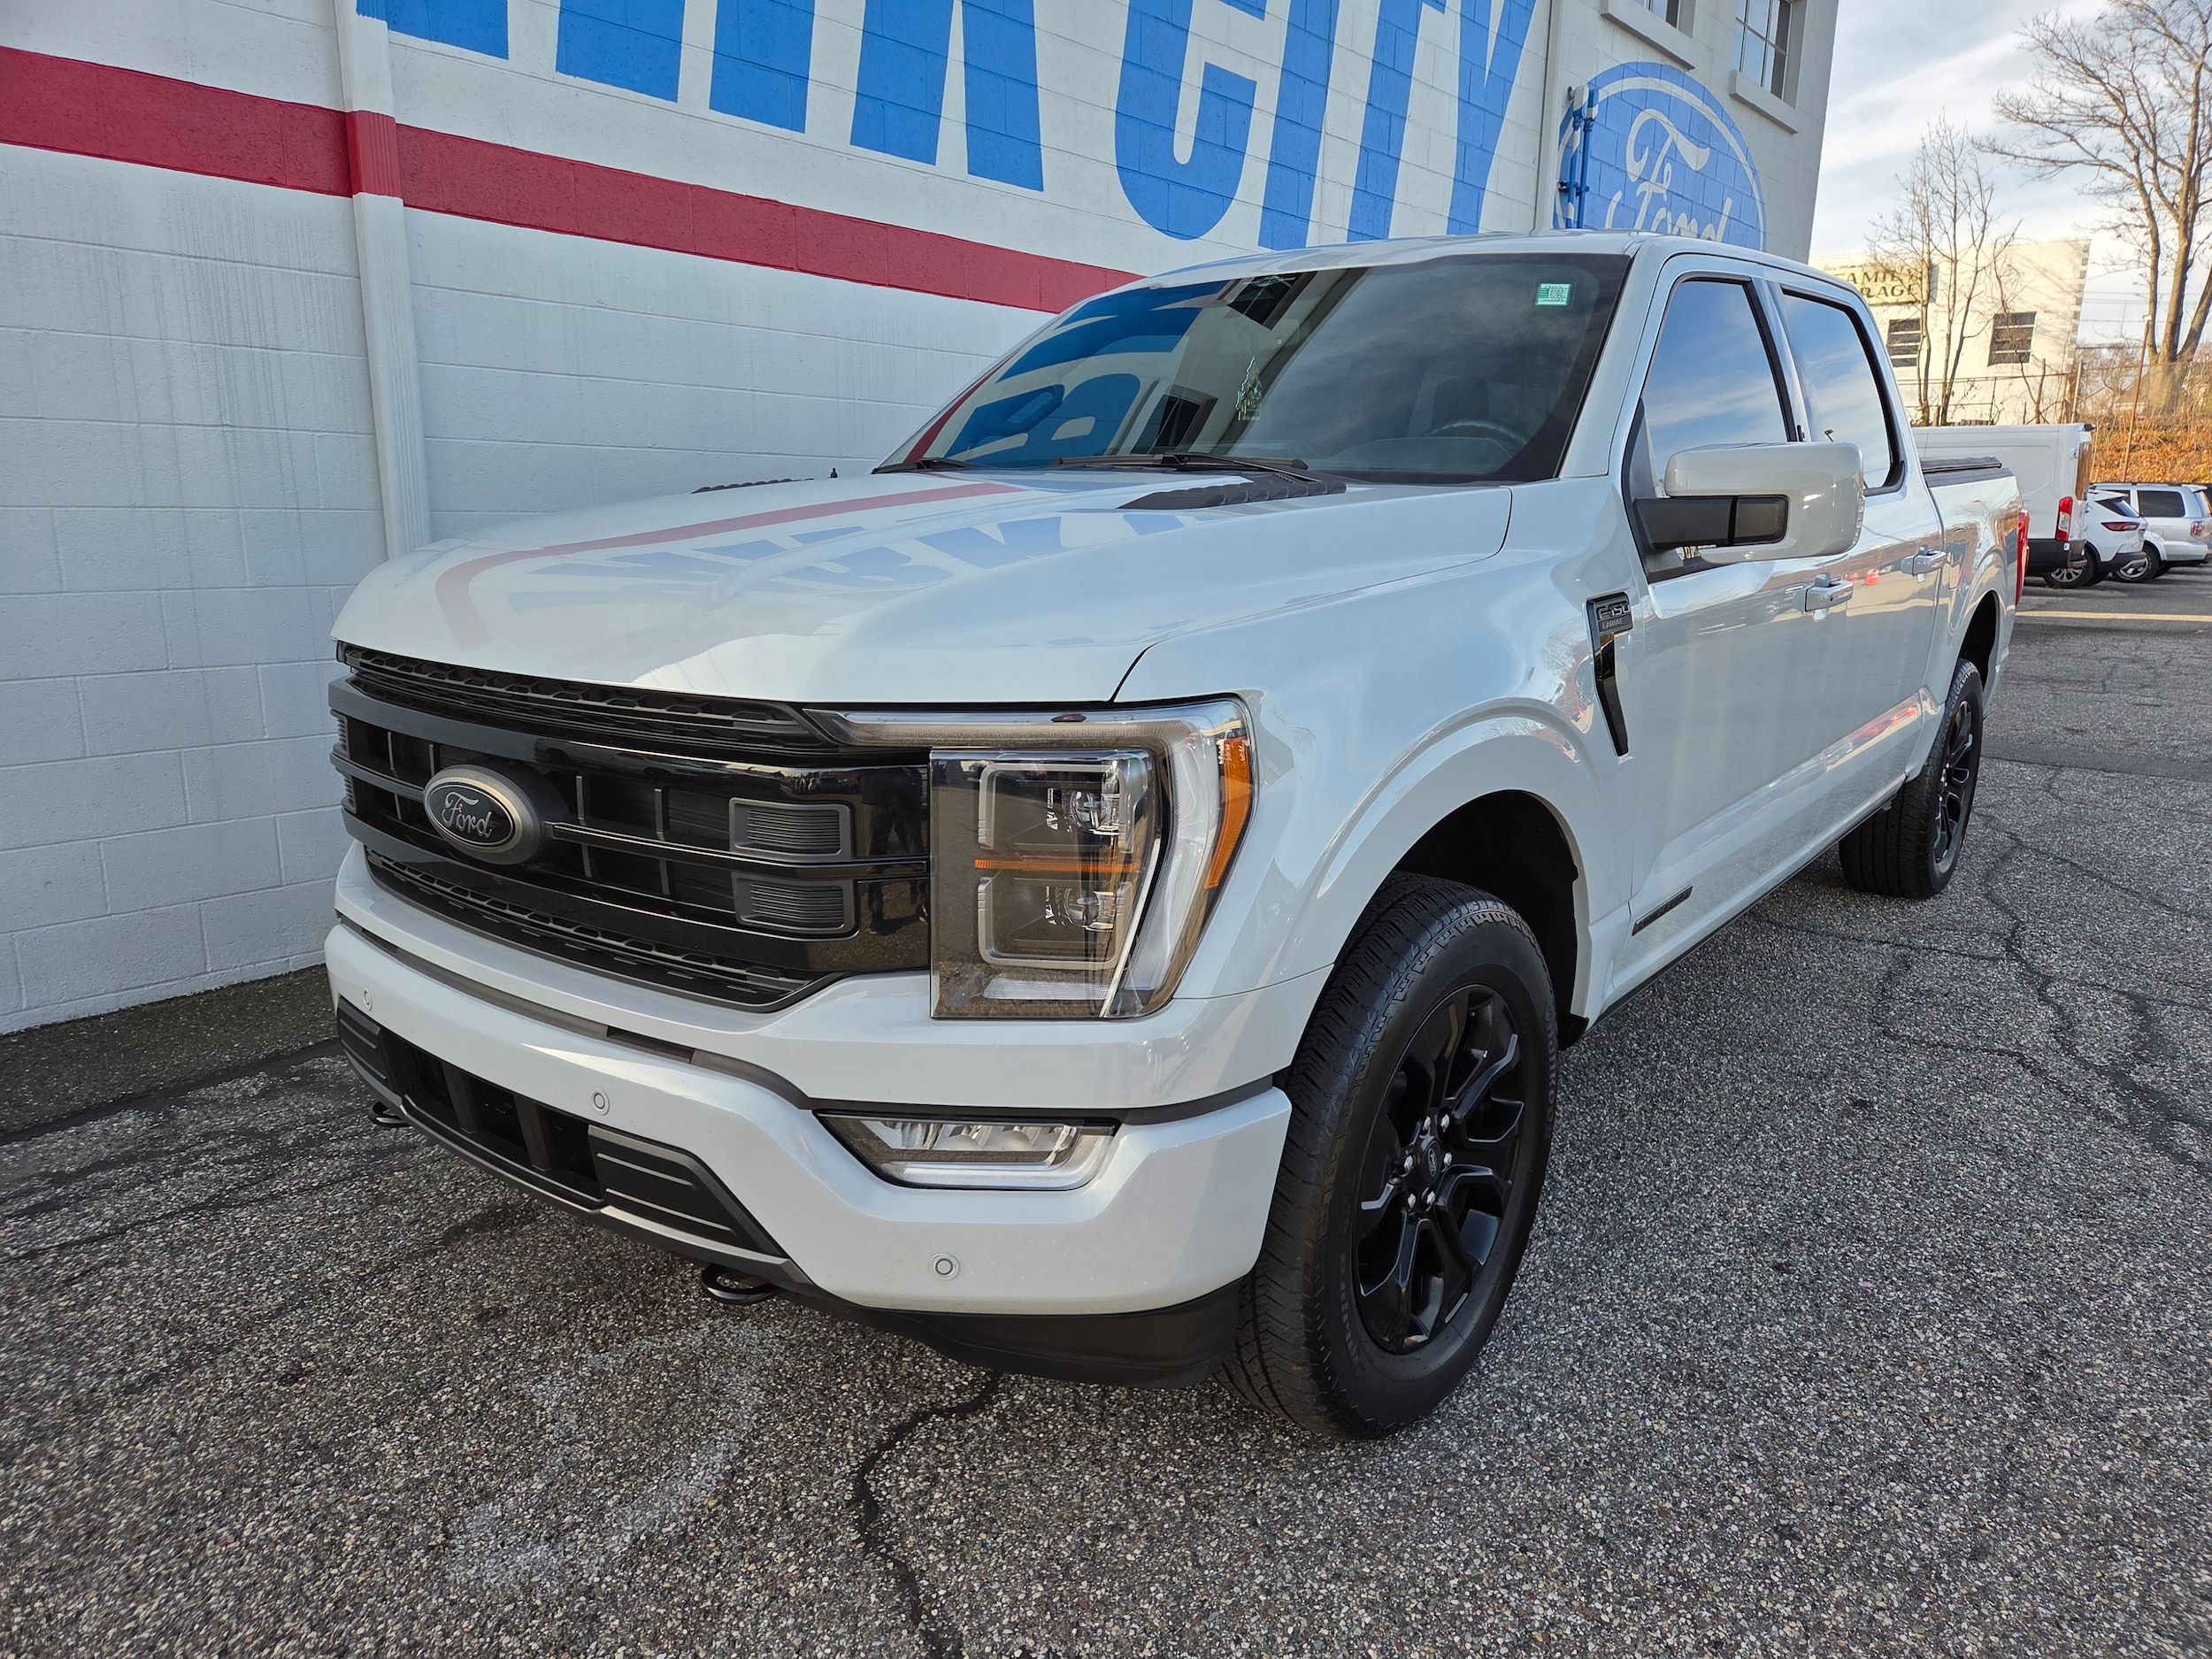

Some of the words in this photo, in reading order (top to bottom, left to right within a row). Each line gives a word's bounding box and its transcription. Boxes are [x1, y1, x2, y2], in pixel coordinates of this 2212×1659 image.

[1597, 603, 1631, 620] F-150
[1601, 618, 1623, 630] LARIAT
[442, 791, 493, 838] Ford
